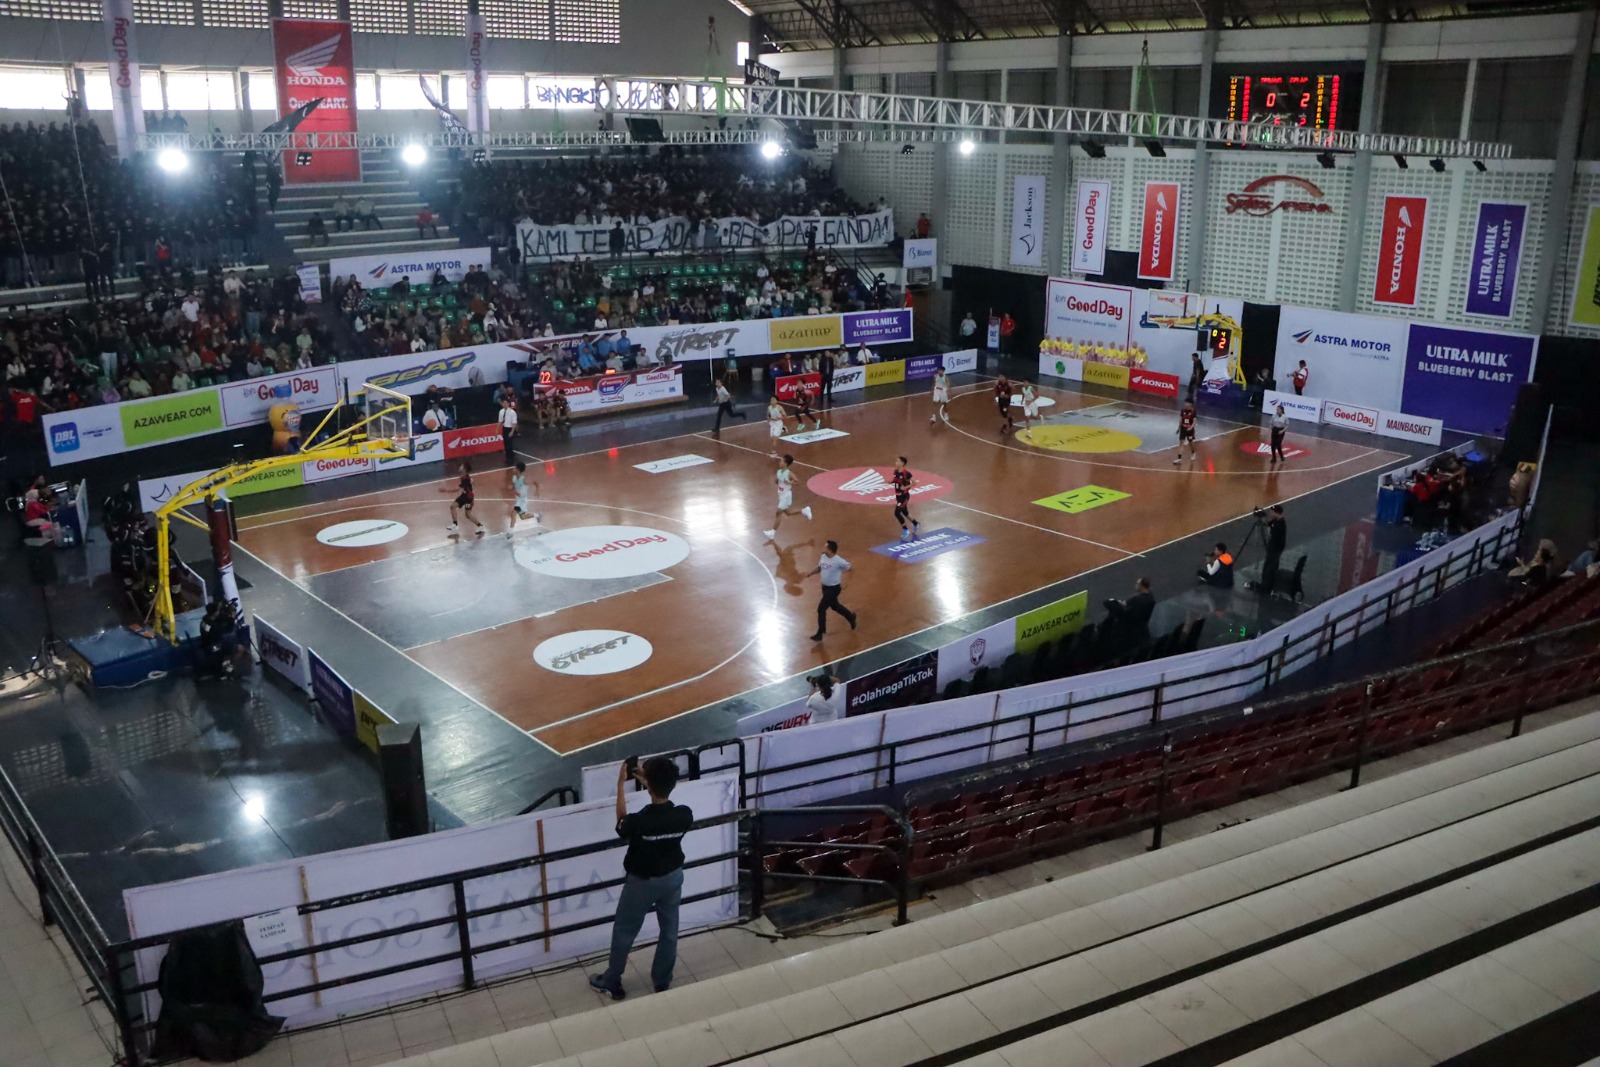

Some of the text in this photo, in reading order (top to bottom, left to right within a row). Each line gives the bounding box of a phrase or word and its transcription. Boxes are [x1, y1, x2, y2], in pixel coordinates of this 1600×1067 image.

[287, 76, 346, 86] HONDA
[1266, 93, 1310, 108] 0 2
[1023, 187, 1033, 230] Jackson
[521, 228, 569, 257] KAMI
[575, 226, 653, 253] TEAP
[1151, 210, 1163, 270] HONDA
[391, 260, 462, 274] ASTRA MOTOR
[1390, 226, 1406, 295] HONDA
[1492, 219, 1512, 302] BLUEBERRY BLAST
[856, 316, 899, 328] ULTRA MILK
[853, 329, 883, 337] BLUEBERRY
[1218, 338, 1227, 349] 2
[1314, 334, 1391, 352] ASTRA MOTOR
[1426, 345, 1508, 367] ULTRA MILK
[540, 371, 551, 384] 22
[1418, 361, 1514, 383] BLUEBERRY BLAST
[557, 385, 590, 395] ONDA
[1142, 379, 1175, 390] HONDA
[1297, 404, 1316, 412] MOTOR
[133, 405, 212, 429] AZAWEAR.COM
[1386, 419, 1433, 436] MAINBASKET
[461, 434, 503, 447] HONDA
[239, 468, 295, 483] AWEAR.COM
[1021, 610, 1081, 640] AZAWEAR.COM
[851, 668, 933, 707] #OlahragaTikTok
[260, 922, 284, 933] TEMPAT
[260, 928, 286, 939] SAMPAH
